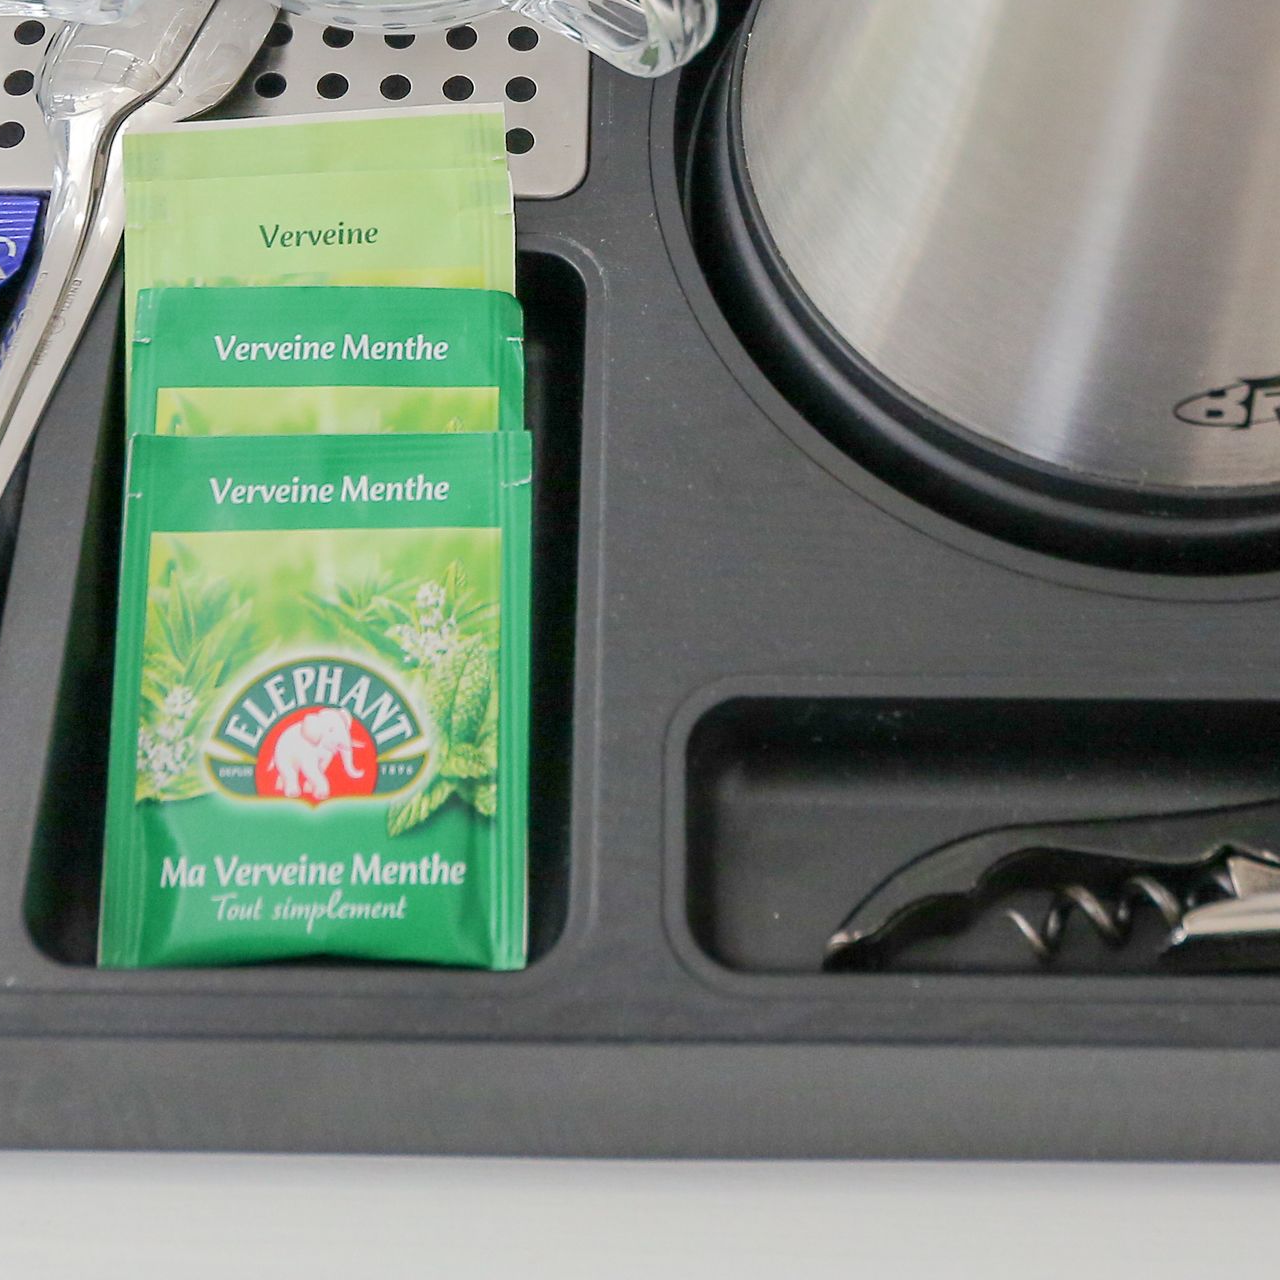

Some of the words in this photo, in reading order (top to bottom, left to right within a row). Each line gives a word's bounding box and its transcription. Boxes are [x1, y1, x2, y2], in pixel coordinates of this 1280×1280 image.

[259, 221, 379, 249] Verveine
[214, 334, 335, 361] Verveine
[342, 333, 449, 361] Menthe
[209, 476, 334, 504] Verveine
[340, 474, 450, 503] Menthe
[224, 665, 417, 749] ELEPHANT
[160, 858, 206, 888] Ma
[214, 854, 343, 888] Verveine
[351, 853, 467, 887] Menthe
[210, 893, 263, 921] Tout
[274, 889, 408, 934] simplement
